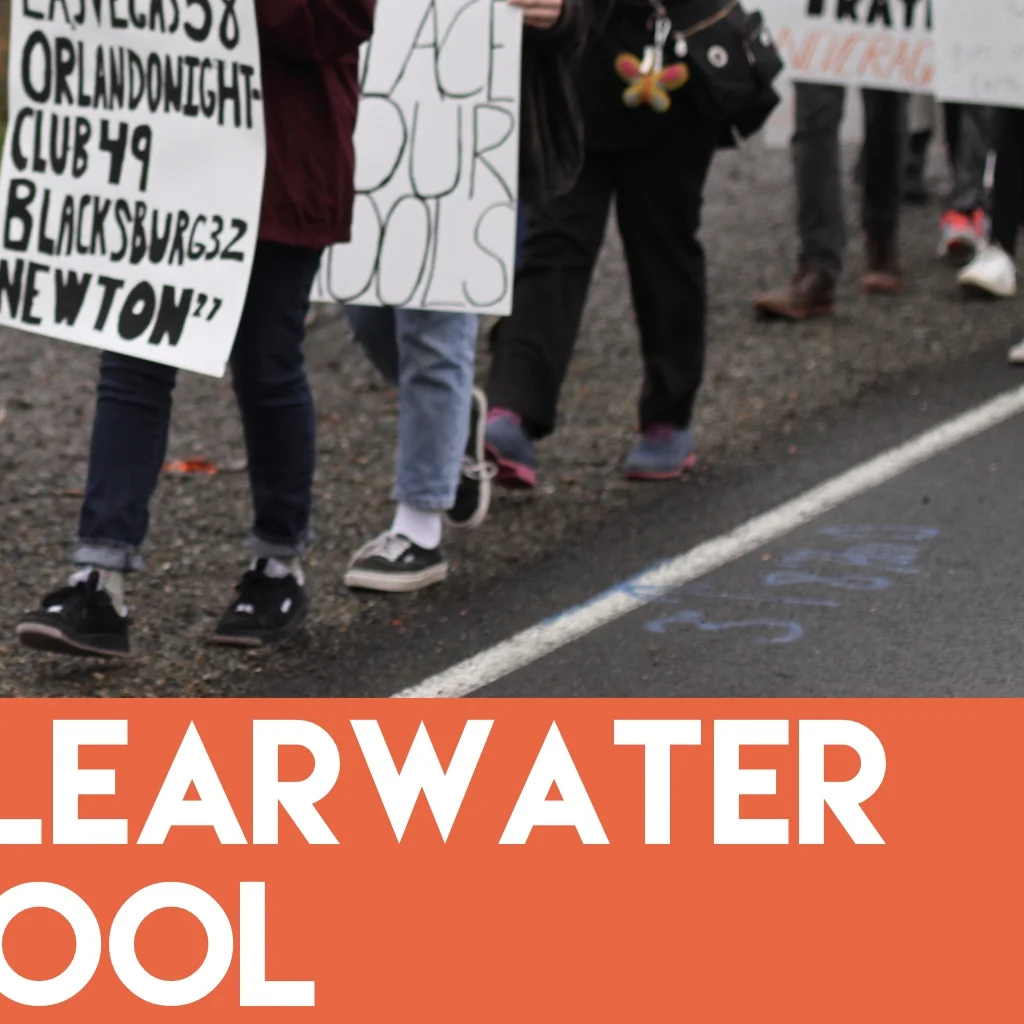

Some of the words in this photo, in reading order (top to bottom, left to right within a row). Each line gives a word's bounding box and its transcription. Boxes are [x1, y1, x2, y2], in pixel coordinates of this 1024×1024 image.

[11, 107, 92, 181] CLUB
[98, 119, 153, 192] 49
[318, 193, 516, 308] OOLS
